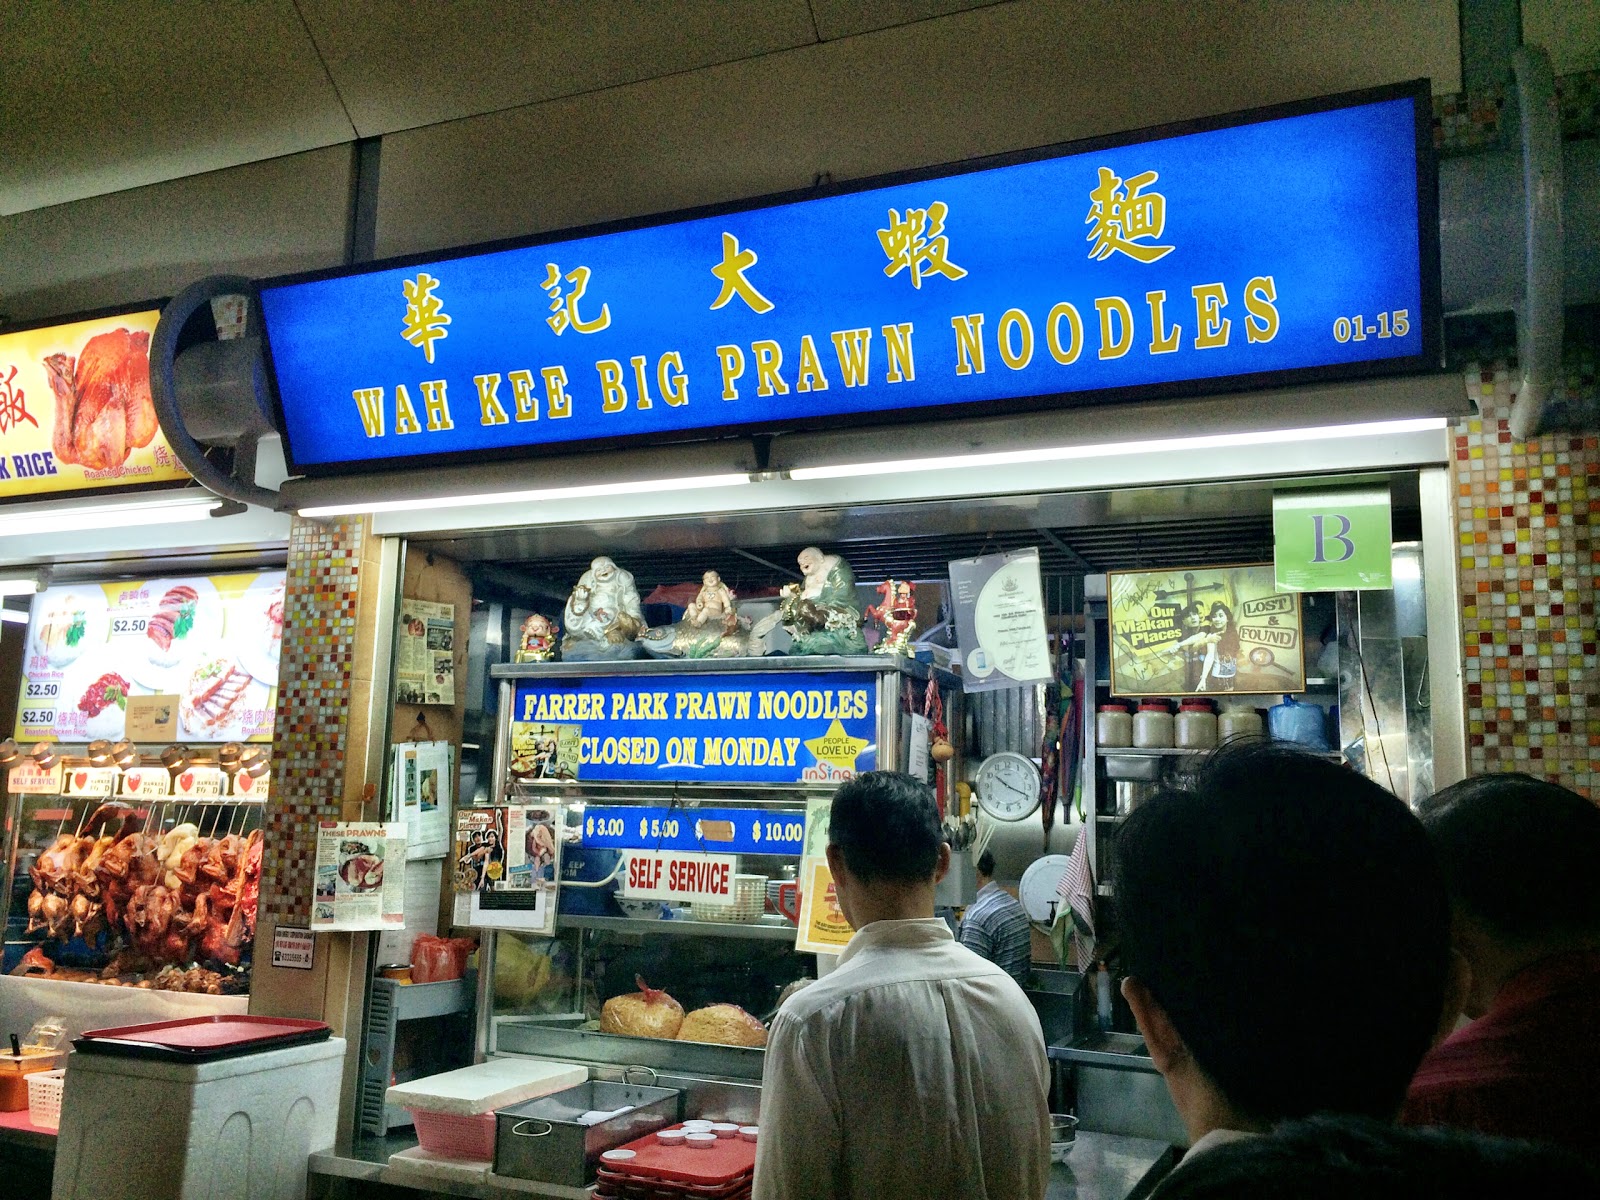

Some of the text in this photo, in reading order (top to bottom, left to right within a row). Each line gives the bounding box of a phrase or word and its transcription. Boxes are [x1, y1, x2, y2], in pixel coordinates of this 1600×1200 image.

[1332, 308, 1411, 344] 01-15
[352, 275, 1280, 439] WAH KEE BIG PRAWN NOODLES
[14, 451, 58, 479] RICE
[84, 464, 153, 479] Roasted Chicken
[1307, 513, 1356, 563] B
[1151, 606, 1176, 618] Our
[1246, 597, 1288, 614] LOST
[113, 619, 146, 632] $2.50
[1115, 618, 1174, 635] Makan
[1267, 616, 1280, 626] &
[1130, 627, 1183, 648] Places
[1241, 628, 1292, 645] FOUND
[27, 684, 58, 696] $2.50
[523, 690, 869, 721] FARRER PARK PRAWN NOODLES
[22, 711, 53, 723] $2.50
[241, 726, 270, 735] Roasted
[823, 737, 850, 745] PEOPLE
[579, 736, 801, 766] CLOSED ON MONDAY
[816, 745, 857, 755] LOVE US
[13, 777, 56, 786] SELF SERVICE
[63, 772, 73, 793] I
[116, 773, 126, 795] I
[346, 829, 387, 837] PRAWNS
[629, 857, 730, 895] SELF SERVICE
